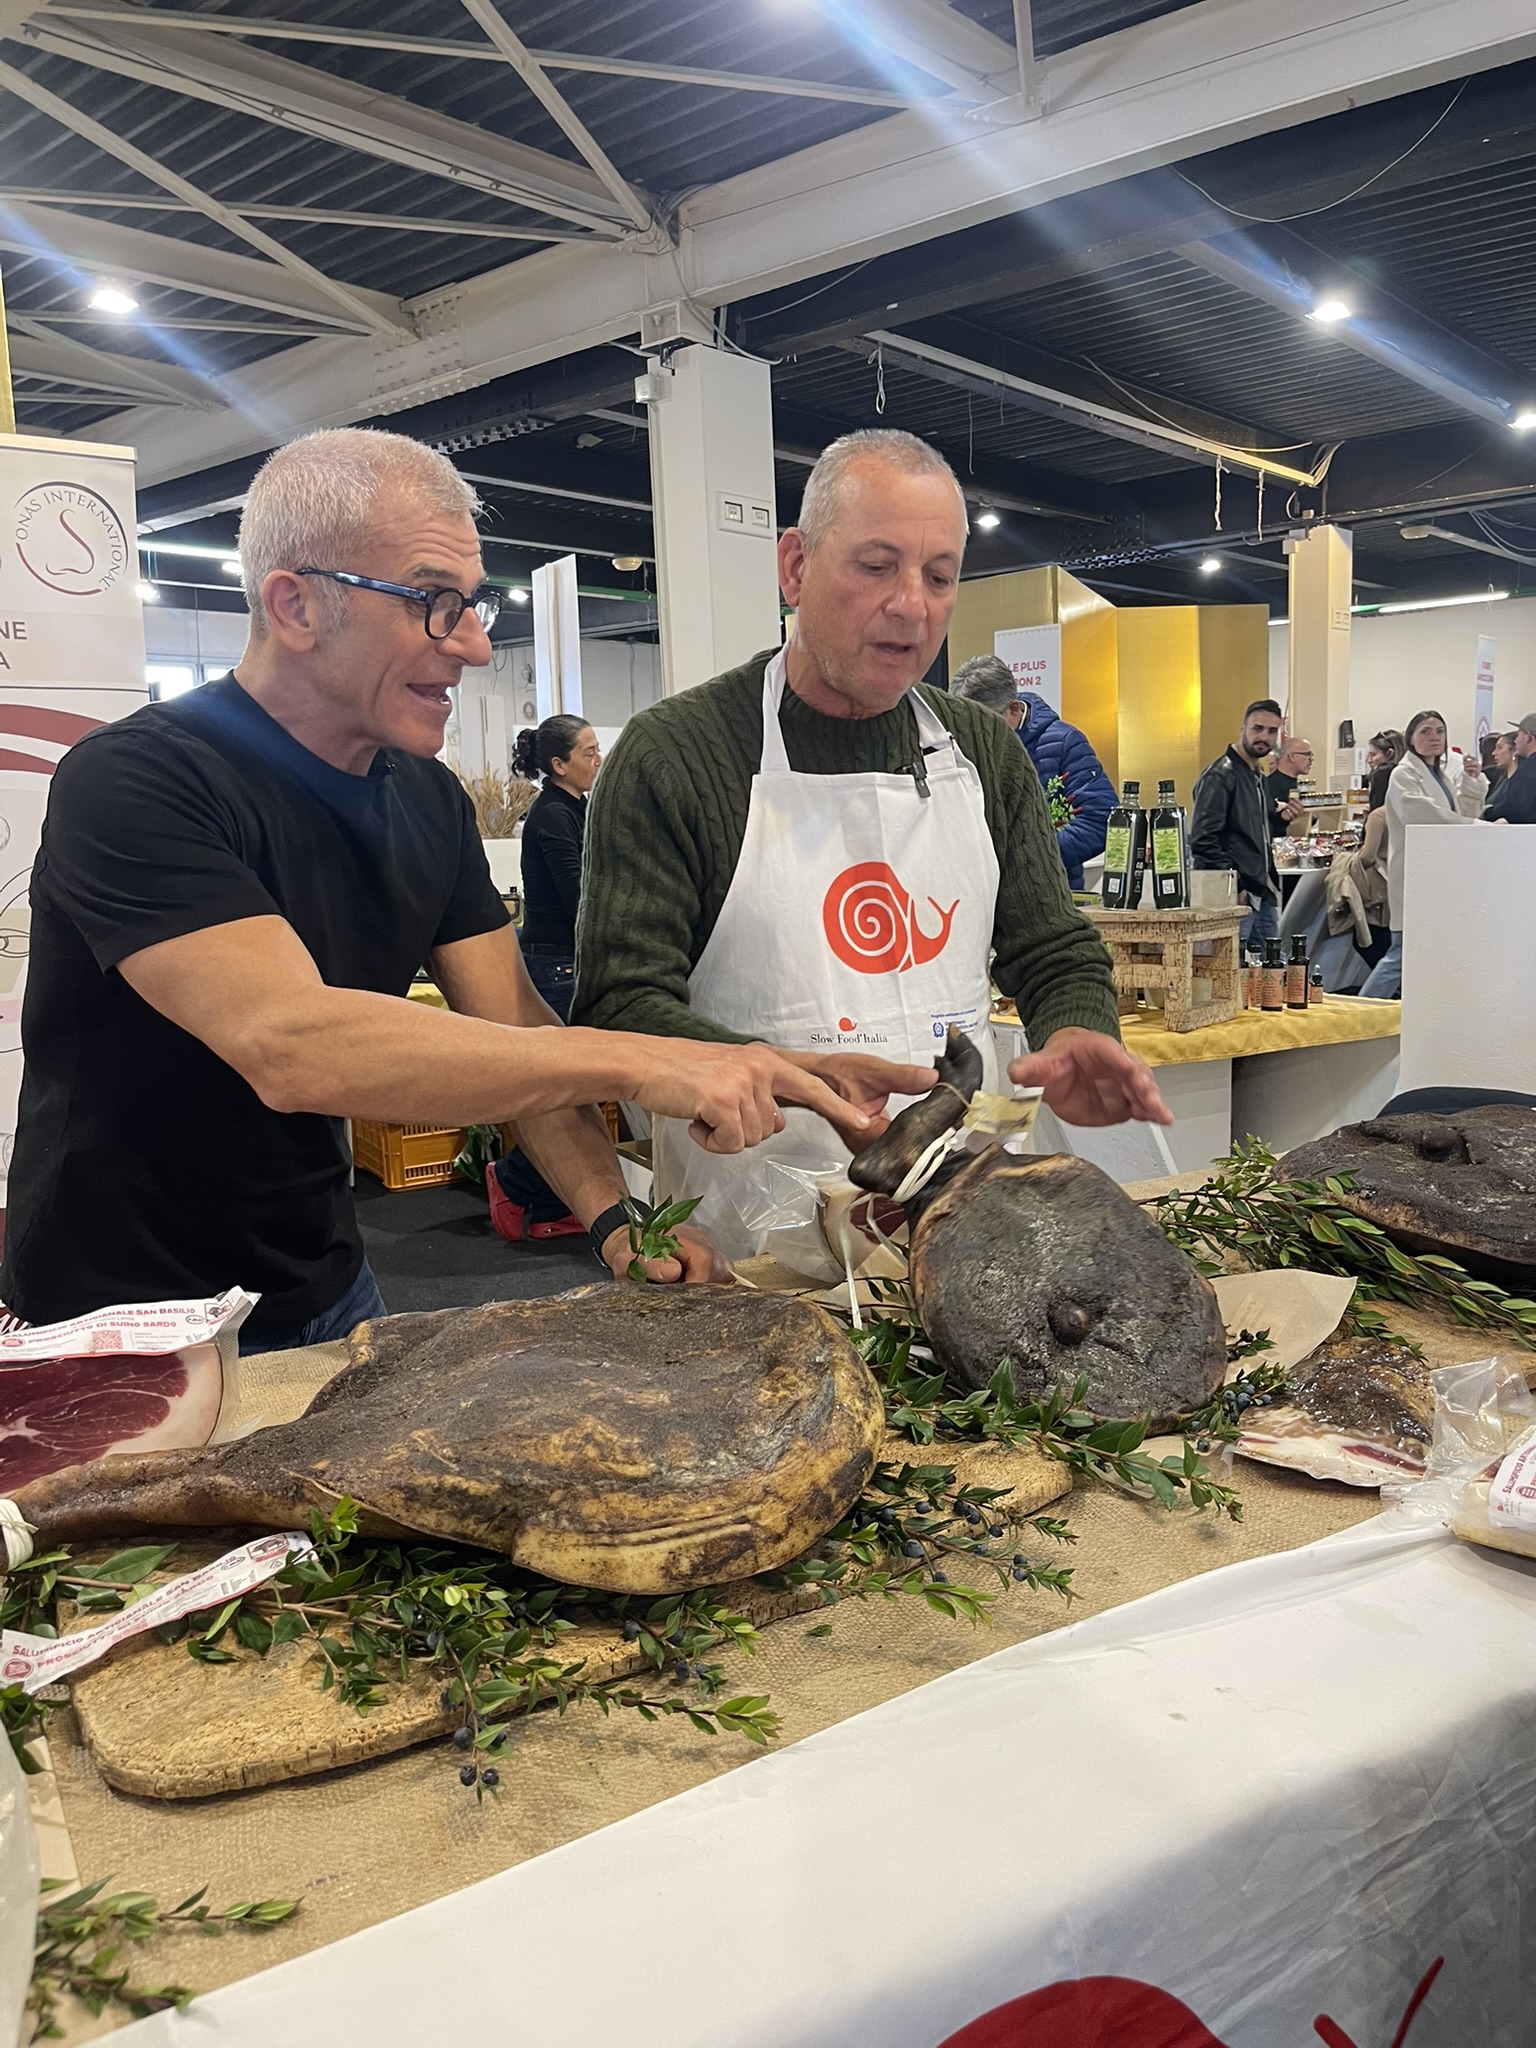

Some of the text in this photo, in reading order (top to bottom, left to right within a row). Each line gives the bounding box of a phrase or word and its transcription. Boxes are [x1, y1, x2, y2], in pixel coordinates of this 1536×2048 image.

[15, 490, 123, 588] ONAS INTERNATIONAL
[1020, 660, 1047, 672] PLUS
[1035, 676, 1042, 686] 2
[810, 1033, 834, 1044] Slow
[863, 1033, 888, 1044] Italia
